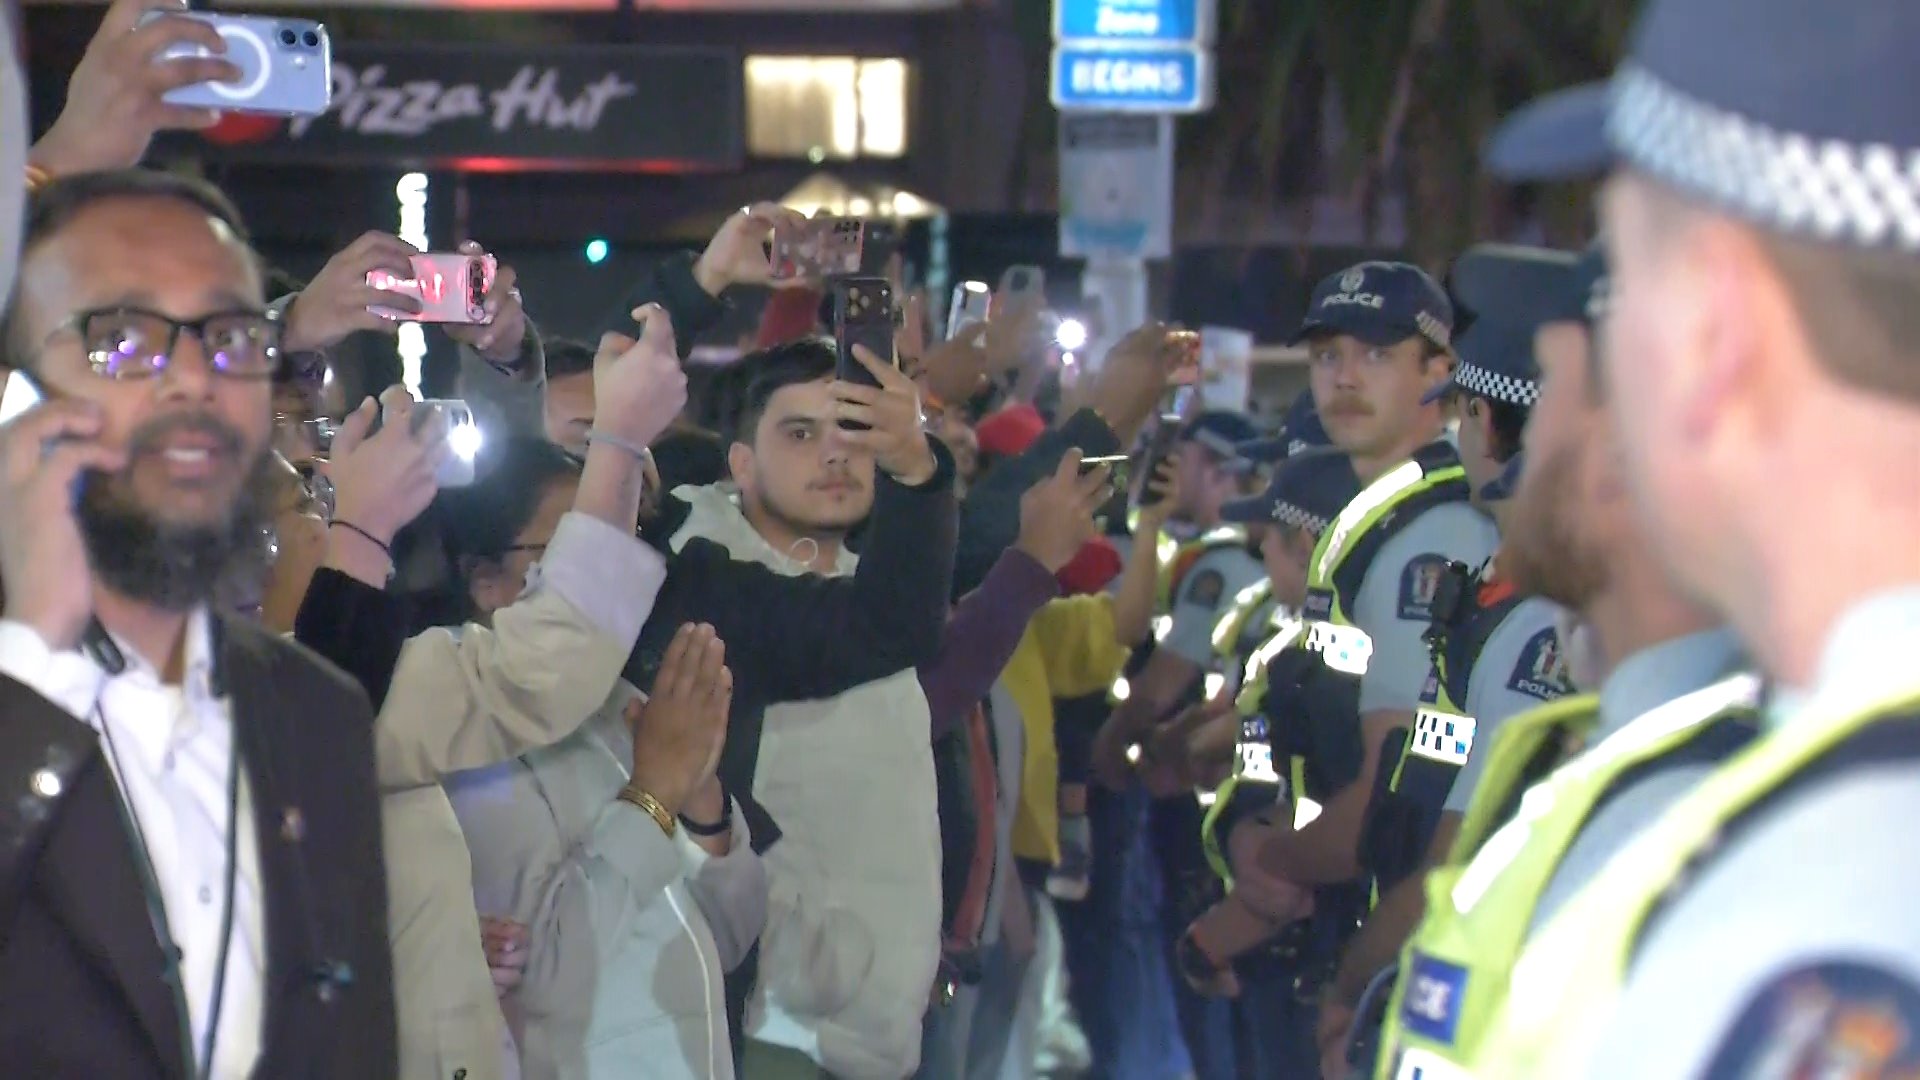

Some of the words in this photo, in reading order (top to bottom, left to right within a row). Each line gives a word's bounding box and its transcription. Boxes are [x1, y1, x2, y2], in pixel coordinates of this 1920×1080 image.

[1072, 59, 1182, 94] BEGINS
[492, 64, 637, 133] Hut
[1321, 293, 1384, 309] POLICE
